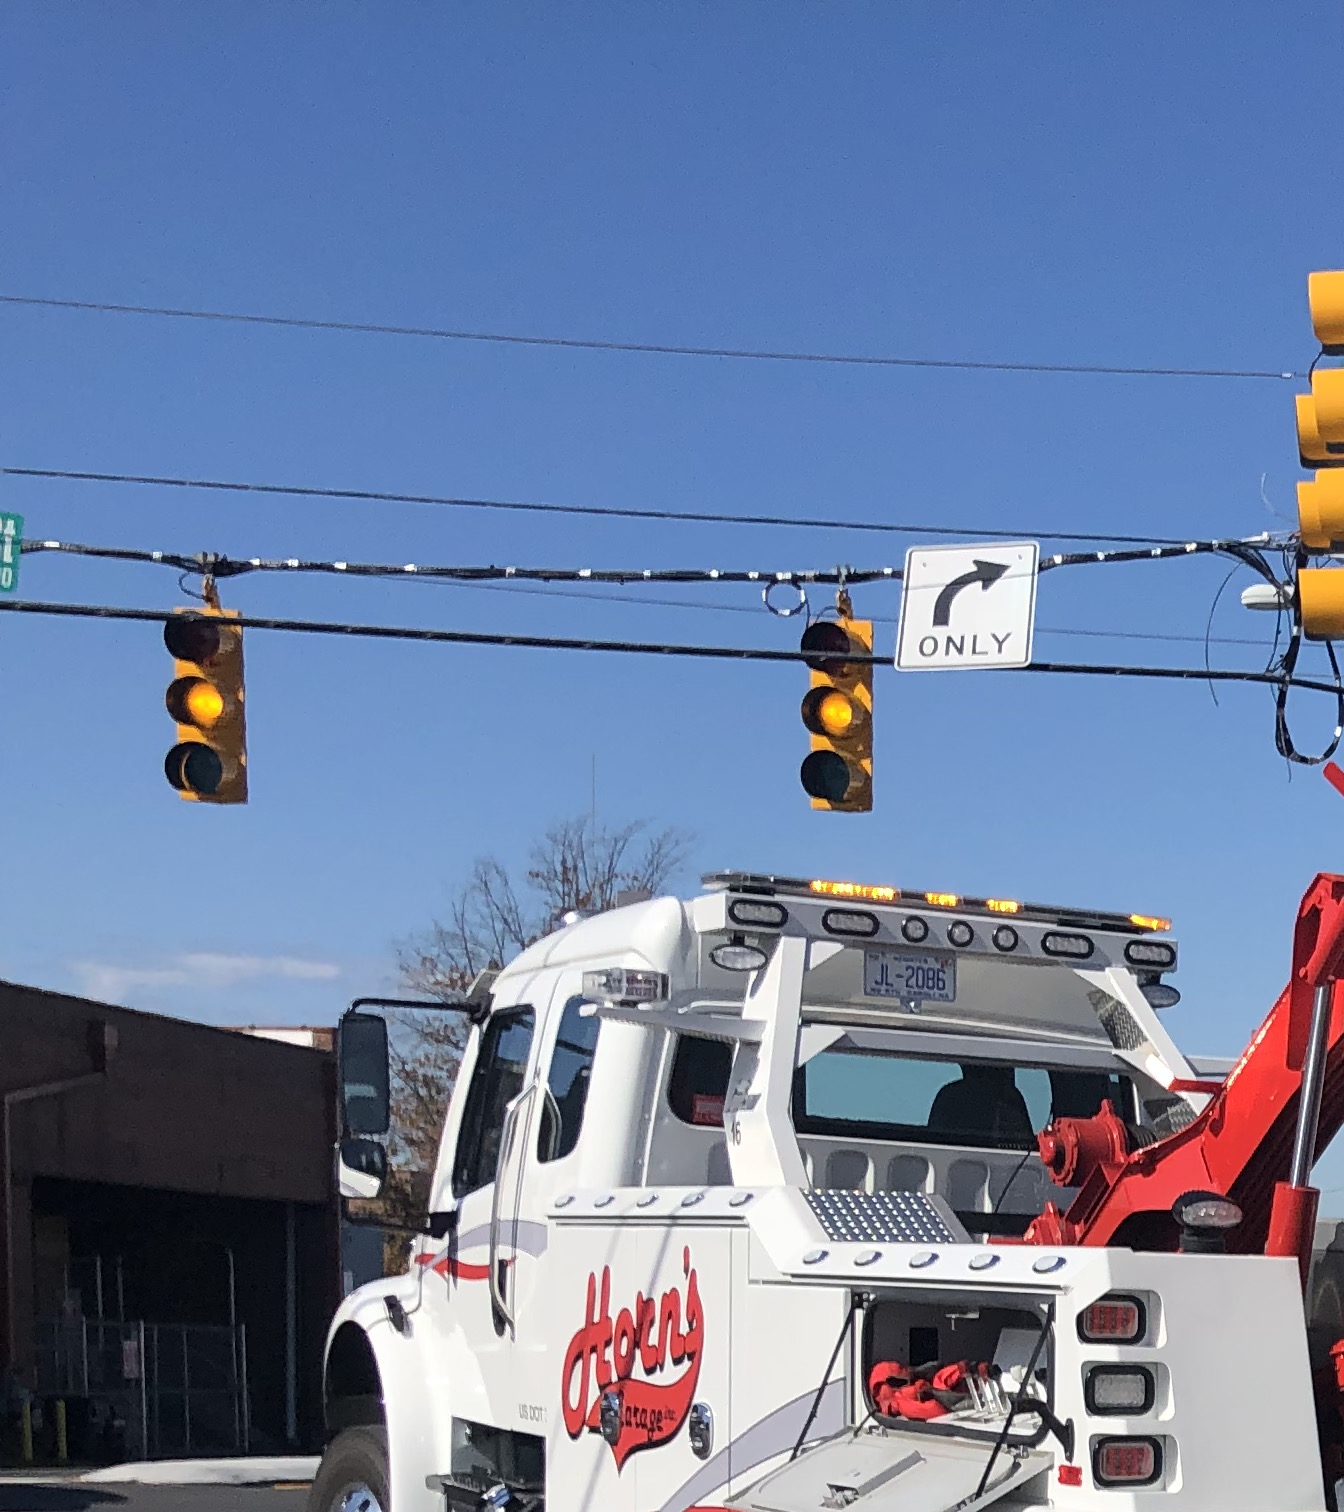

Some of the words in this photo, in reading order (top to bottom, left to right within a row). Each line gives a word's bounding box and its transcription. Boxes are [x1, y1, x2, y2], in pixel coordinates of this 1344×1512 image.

[918, 632, 1013, 657] ONLY
[874, 963, 946, 991] JL-2086
[619, 1404, 664, 1441] arage
